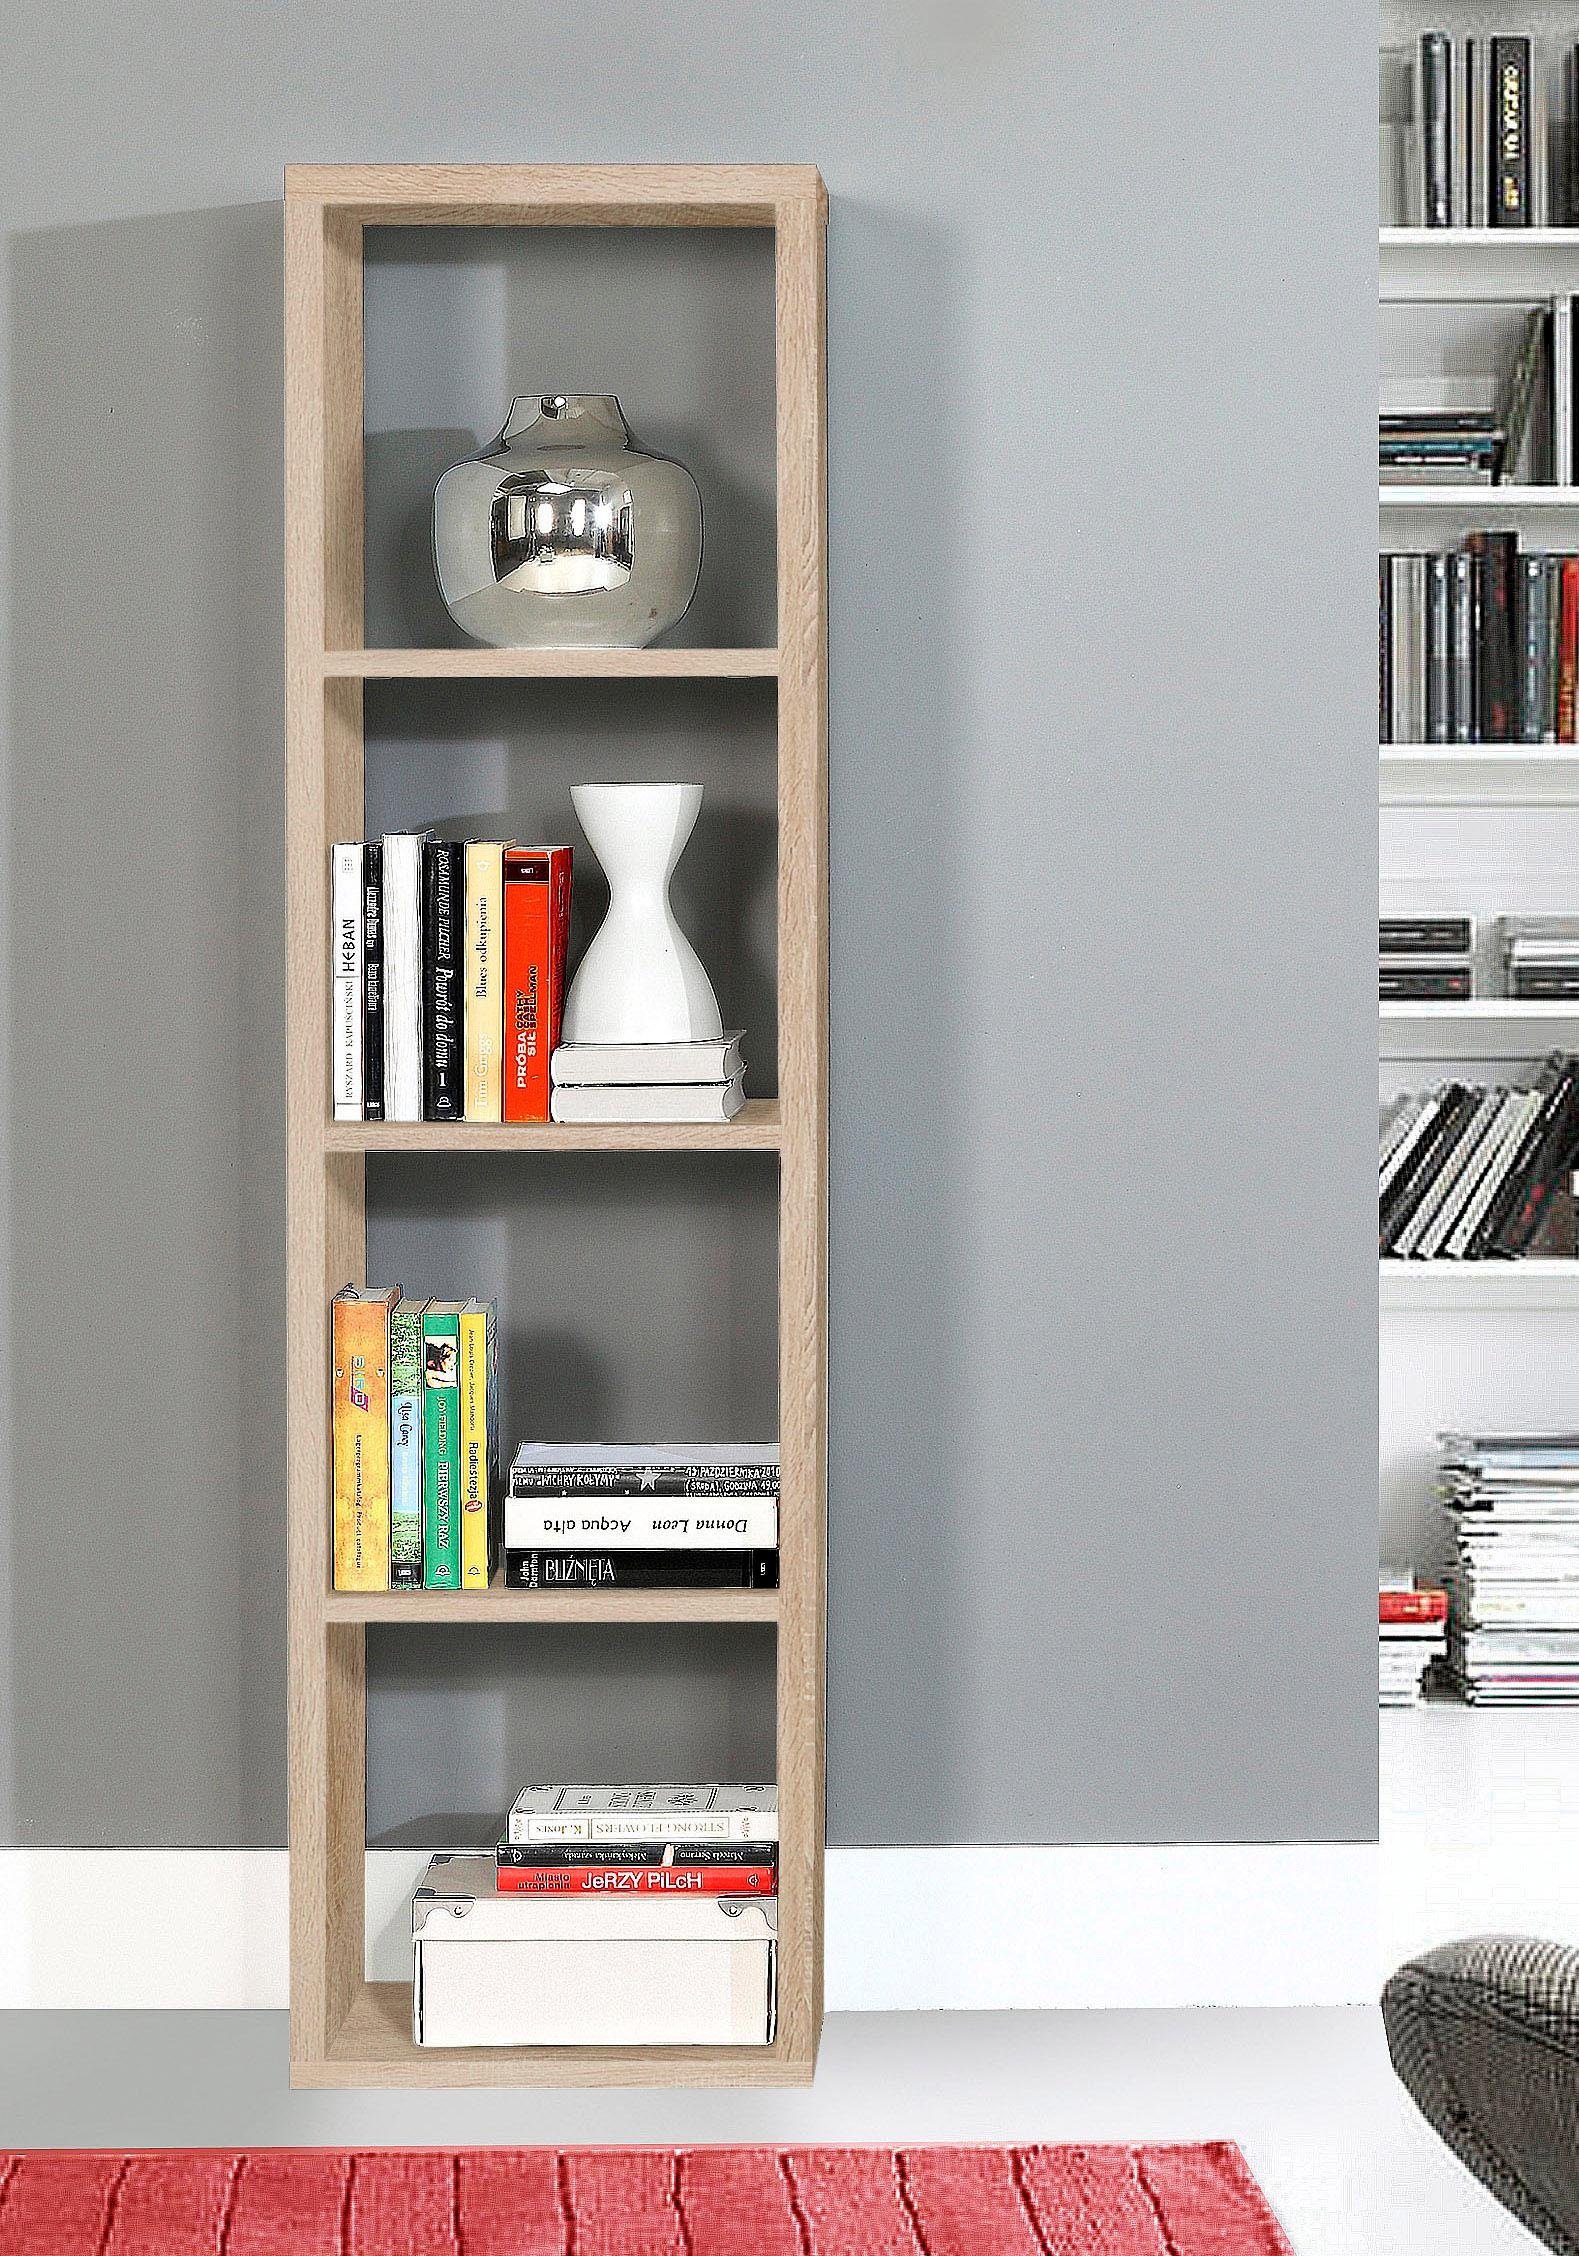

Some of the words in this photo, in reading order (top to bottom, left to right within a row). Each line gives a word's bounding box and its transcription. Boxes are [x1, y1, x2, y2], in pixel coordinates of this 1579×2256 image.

[436, 848, 451, 915] ROSAMUNDE
[437, 916, 451, 961] PILCHER
[475, 896, 491, 963] odkupienia
[342, 918, 355, 972] HEBAN
[434, 966, 454, 1011] Powrót
[475, 967, 488, 999] Blues
[529, 965, 538, 1030] SPELLMAN
[435, 1013, 453, 1030] do
[515, 990, 524, 1030] CATHY
[522, 997, 531, 1030] CASH
[435, 1032, 453, 1068] domu
[527, 1031, 537, 1057] SIŁ
[514, 1031, 527, 1088] PRÓBA
[343, 1053, 353, 1099] RYSZARD
[354, 1355, 366, 1407] SIRO
[436, 1396, 447, 1413] JOY
[437, 1415, 447, 1456] FIELDING
[467, 1442, 480, 1499] Radiestezja
[437, 1461, 449, 1523] PIERWSZY
[724, 1480, 758, 1491] GODZINA
[355, 1511, 363, 1536] Product
[437, 1524, 449, 1550] RAZ
[543, 1519, 577, 1535] alta
[581, 1516, 632, 1534] Acqua
[651, 1519, 689, 1534] Leon
[695, 1519, 748, 1534] Donna
[519, 1560, 530, 1581] John
[529, 1553, 539, 1588] Darnton
[545, 1554, 616, 1587] BLIŹNIĘTA
[569, 1823, 583, 1835] K.
[596, 1821, 664, 1835] FLOWERS
[666, 1821, 725, 1835] STRONG
[680, 1850, 711, 1860] Serrano
[517, 1880, 570, 1890] utrapienia
[534, 1872, 570, 1882] Miasto
[581, 1871, 645, 1890] JeRZY
